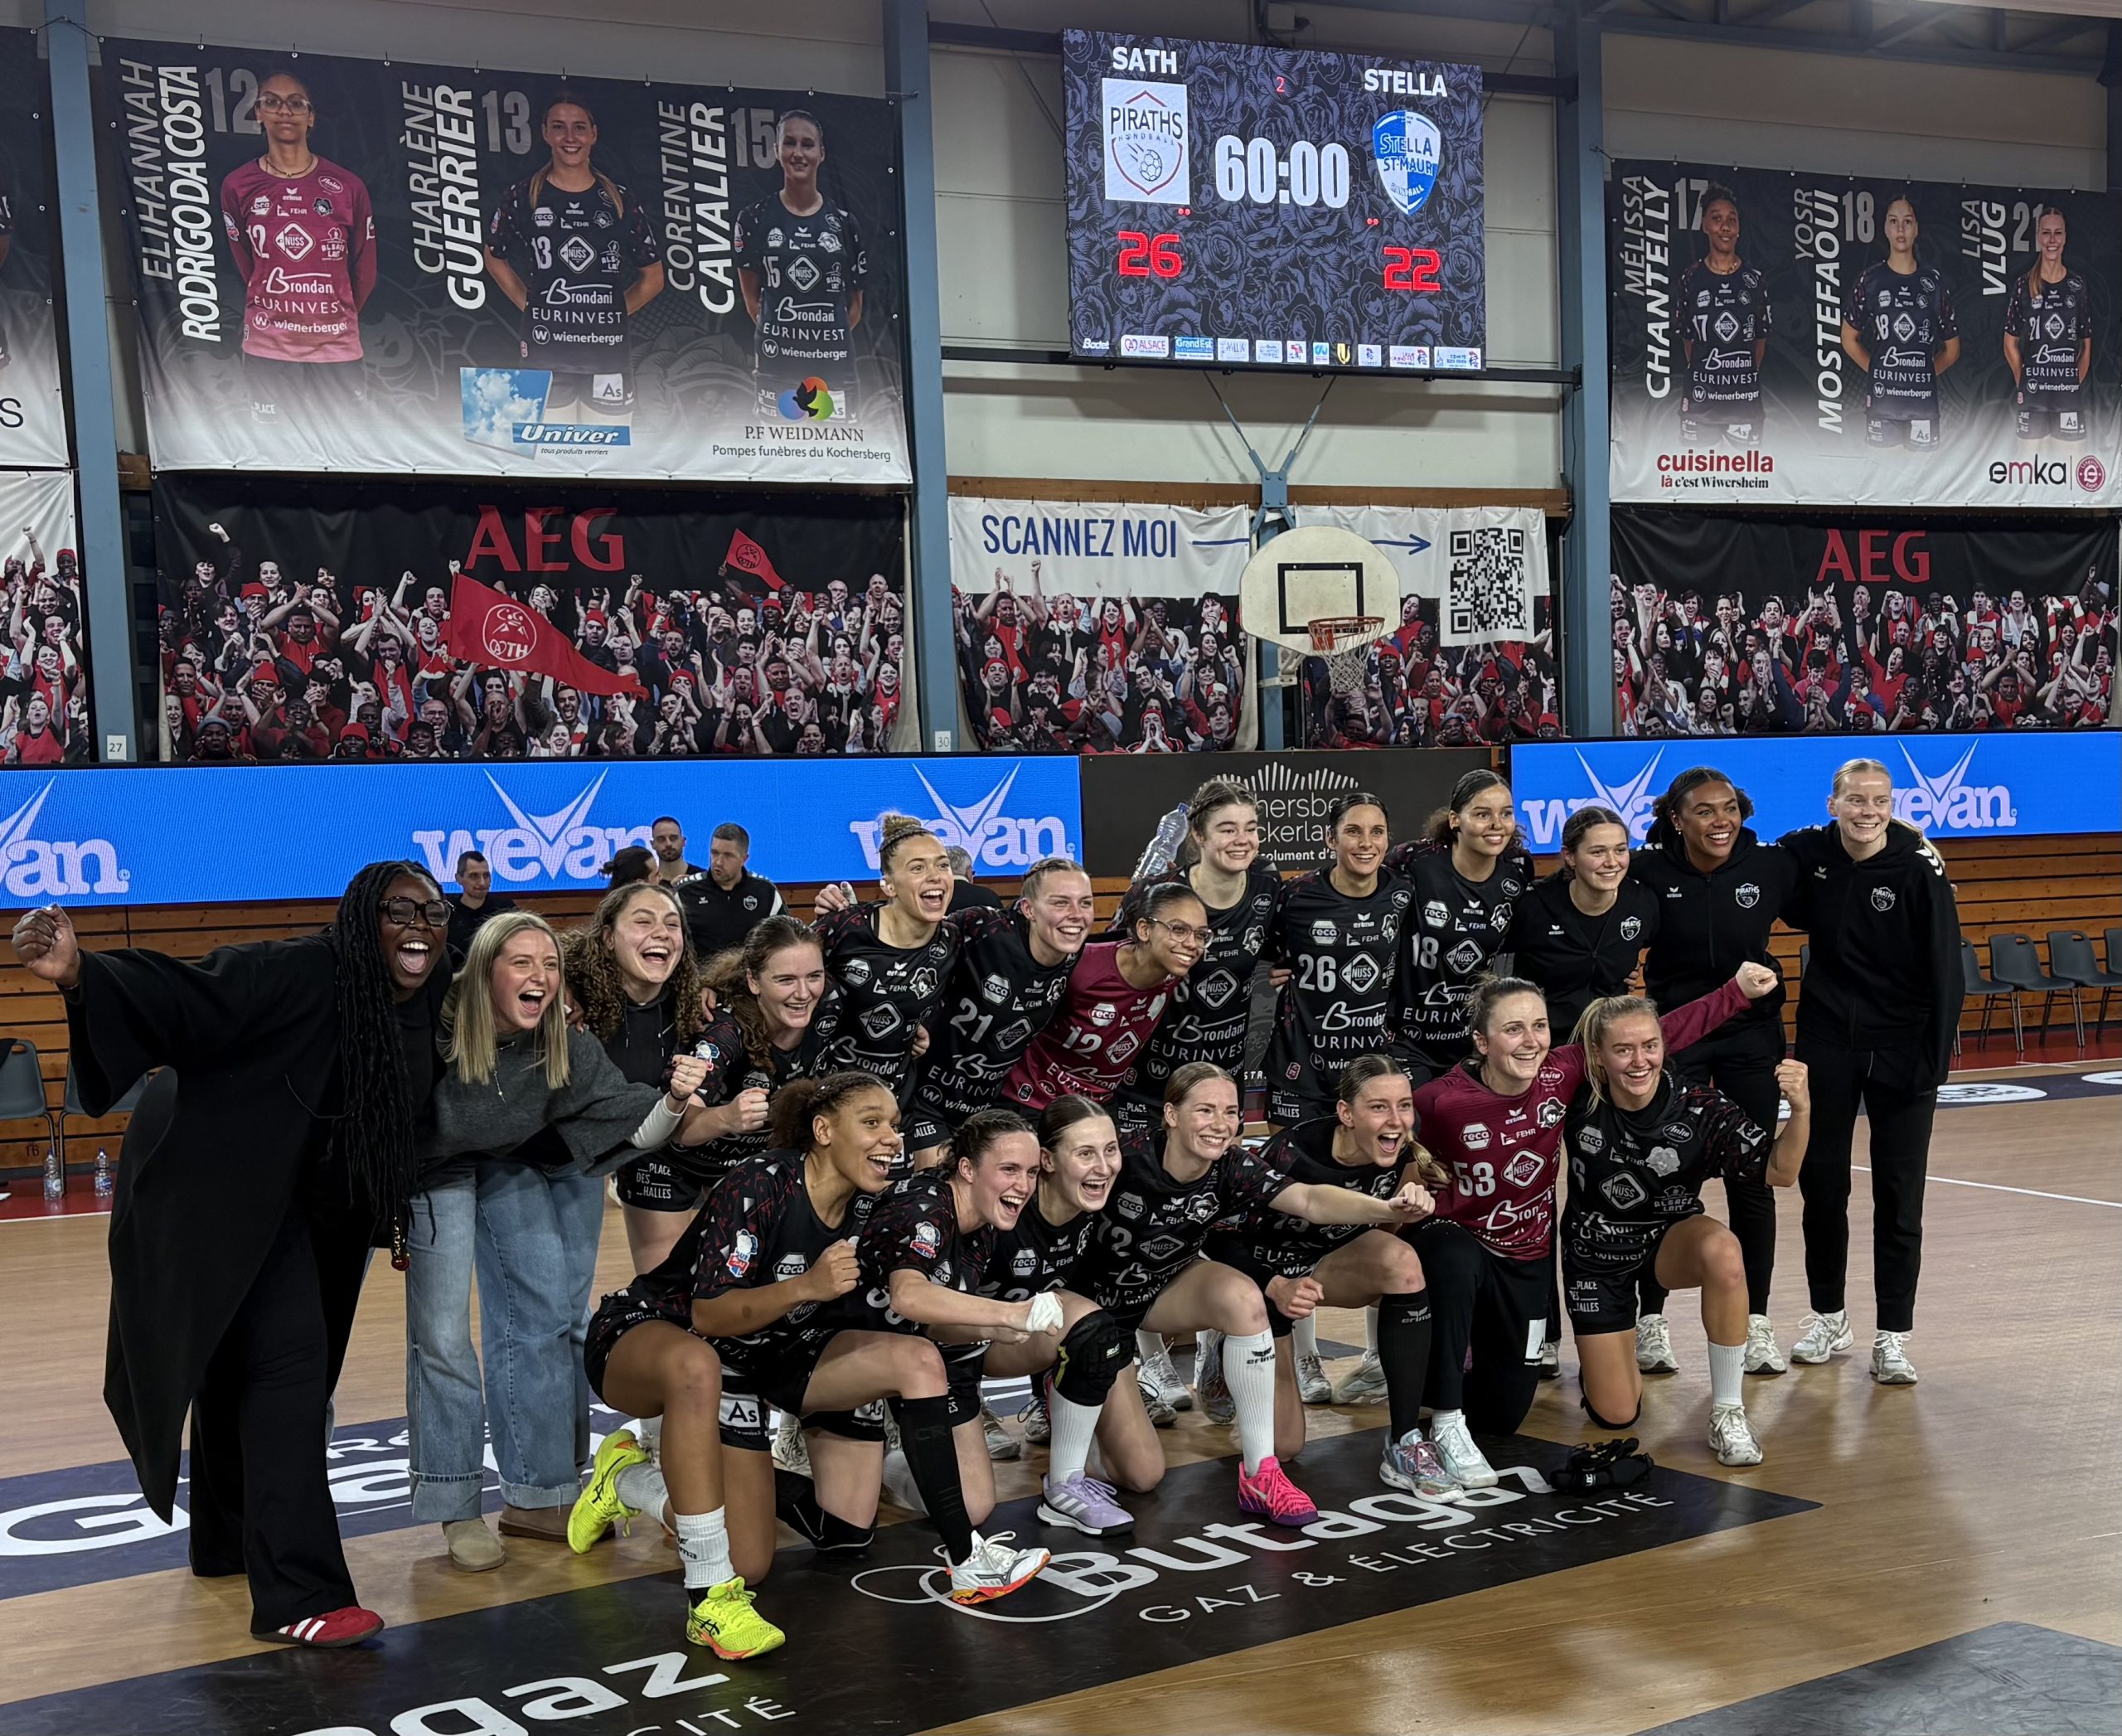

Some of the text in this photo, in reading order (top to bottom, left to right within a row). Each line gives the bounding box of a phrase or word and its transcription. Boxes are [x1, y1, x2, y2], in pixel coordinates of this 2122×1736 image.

[1112, 46, 1177, 74] SATH
[1277, 77, 1285, 93] 2
[1364, 69, 1447, 97] STELLA
[205, 67, 263, 134] 12
[482, 90, 532, 156] 13
[1111, 107, 1184, 140] PIRATHS
[731, 108, 776, 168] 15
[1380, 133, 1432, 157] STELLA
[119, 58, 172, 280] ELIHANNAH
[400, 80, 443, 274] CHARLÈNE
[1214, 135, 1349, 208] 60:00
[158, 66, 221, 342] RODRIGO DA COSTA
[434, 84, 486, 310] GUERRIER
[658, 100, 695, 291] CORENTINE
[1674, 177, 1708, 230] 17
[690, 102, 735, 313] CAVALIER
[1794, 187, 1814, 260] YOSR
[1843, 192, 1875, 243] 18
[2013, 201, 2042, 252] 21
[1623, 175, 1645, 296] MÉLISSA
[1960, 199, 1981, 258] LISA
[284, 235, 305, 247] NUSS
[1982, 201, 2007, 296] VLUG
[568, 248, 587, 259] NUSS
[1117, 231, 1183, 278] 26
[763, 256, 781, 288] 15
[795, 269, 812, 278] NUSS
[1383, 247, 1441, 291] 22
[262, 266, 333, 294] Brondan
[1643, 177, 1671, 399] CHANTELLY
[540, 278, 613, 304] Brondani
[532, 308, 622, 324] EURINVEST
[775, 297, 835, 322] Brondani
[1814, 189, 1843, 434] MOSTEFAOUI
[553, 332, 623, 345] wienerberger
[763, 322, 845, 341] EURINVEST
[781, 347, 847, 361] wienerberger
[1139, 340, 1166, 351] ALSACE
[2032, 344, 2075, 364] Brondani
[1702, 348, 1751, 370] Brondani
[1880, 346, 1926, 367] Brondani
[1693, 371, 1758, 385] EURINVEST
[1873, 369, 1931, 382] EURINVEST
[2026, 367, 2079, 377] EURINVEST
[603, 383, 622, 397] As
[1708, 390, 1759, 401] wienerberger
[1887, 388, 1931, 399] wienerberger
[2039, 382, 2080, 393] wienerberger
[2066, 417, 2077, 427] As
[521, 424, 619, 444] Univer
[744, 426, 864, 442] P.F WEIDMANN
[1916, 429, 1930, 440] As
[712, 445, 891, 462] Pompes funèbres du Kochersberg
[1657, 449, 1774, 473] cuisinella
[1989, 453, 2066, 485] emka
[1661, 475, 1769, 488] là c'est Wiwersheim
[465, 505, 625, 572] AEG
[982, 515, 1178, 560] SCANNEZ MOI
[1816, 529, 1931, 583] AEG
[109, 742, 123, 754] 27
[937, 736, 949, 748] 30
[1253, 793, 1340, 819] hersbe
[1257, 821, 1331, 843] ckerla
[1426, 909, 1448, 919] reca
[1311, 928, 1338, 937] reca
[1218, 949, 1238, 958] FEHR
[1412, 933, 1439, 969] 18
[1456, 953, 1475, 963] NUSS
[1298, 954, 1336, 993] 26
[1352, 967, 1372, 978] NUSS
[984, 981, 1008, 996] reca
[1207, 982, 1228, 993] NUSS
[870, 1015, 892, 1026] NUSS
[950, 997, 994, 1044] 21
[1092, 1009, 1116, 1020] reca
[1062, 1026, 1102, 1060] 12
[1151, 1040, 1243, 1062] EURINVES
[1126, 1102, 1147, 1113] PLACE
[1463, 1131, 1490, 1142] reca
[1515, 1128, 1536, 1139] FEHR
[1579, 1133, 1603, 1147] reca
[1665, 1125, 1690, 1137] Anita
[636, 1172, 651, 1184] DES
[649, 1162, 672, 1176] PLACE
[1514, 1161, 1535, 1176] NUSS
[1453, 1161, 1496, 1197] 53
[643, 1186, 671, 1199] HALLES
[1613, 1185, 1635, 1198] NUSS
[1119, 1198, 1143, 1213] reca
[777, 1263, 804, 1274] reca
[1013, 1257, 1036, 1268] reca
[1056, 1255, 1073, 1267] FEHR
[1577, 1281, 1598, 1290] PLACE
[1402, 1313, 1432, 1324] erima
[1247, 1354, 1275, 1365] erima
[729, 1401, 758, 1423] As
[1140, 1492, 1674, 1622] GAZ & ÉLECTRICITÉ
